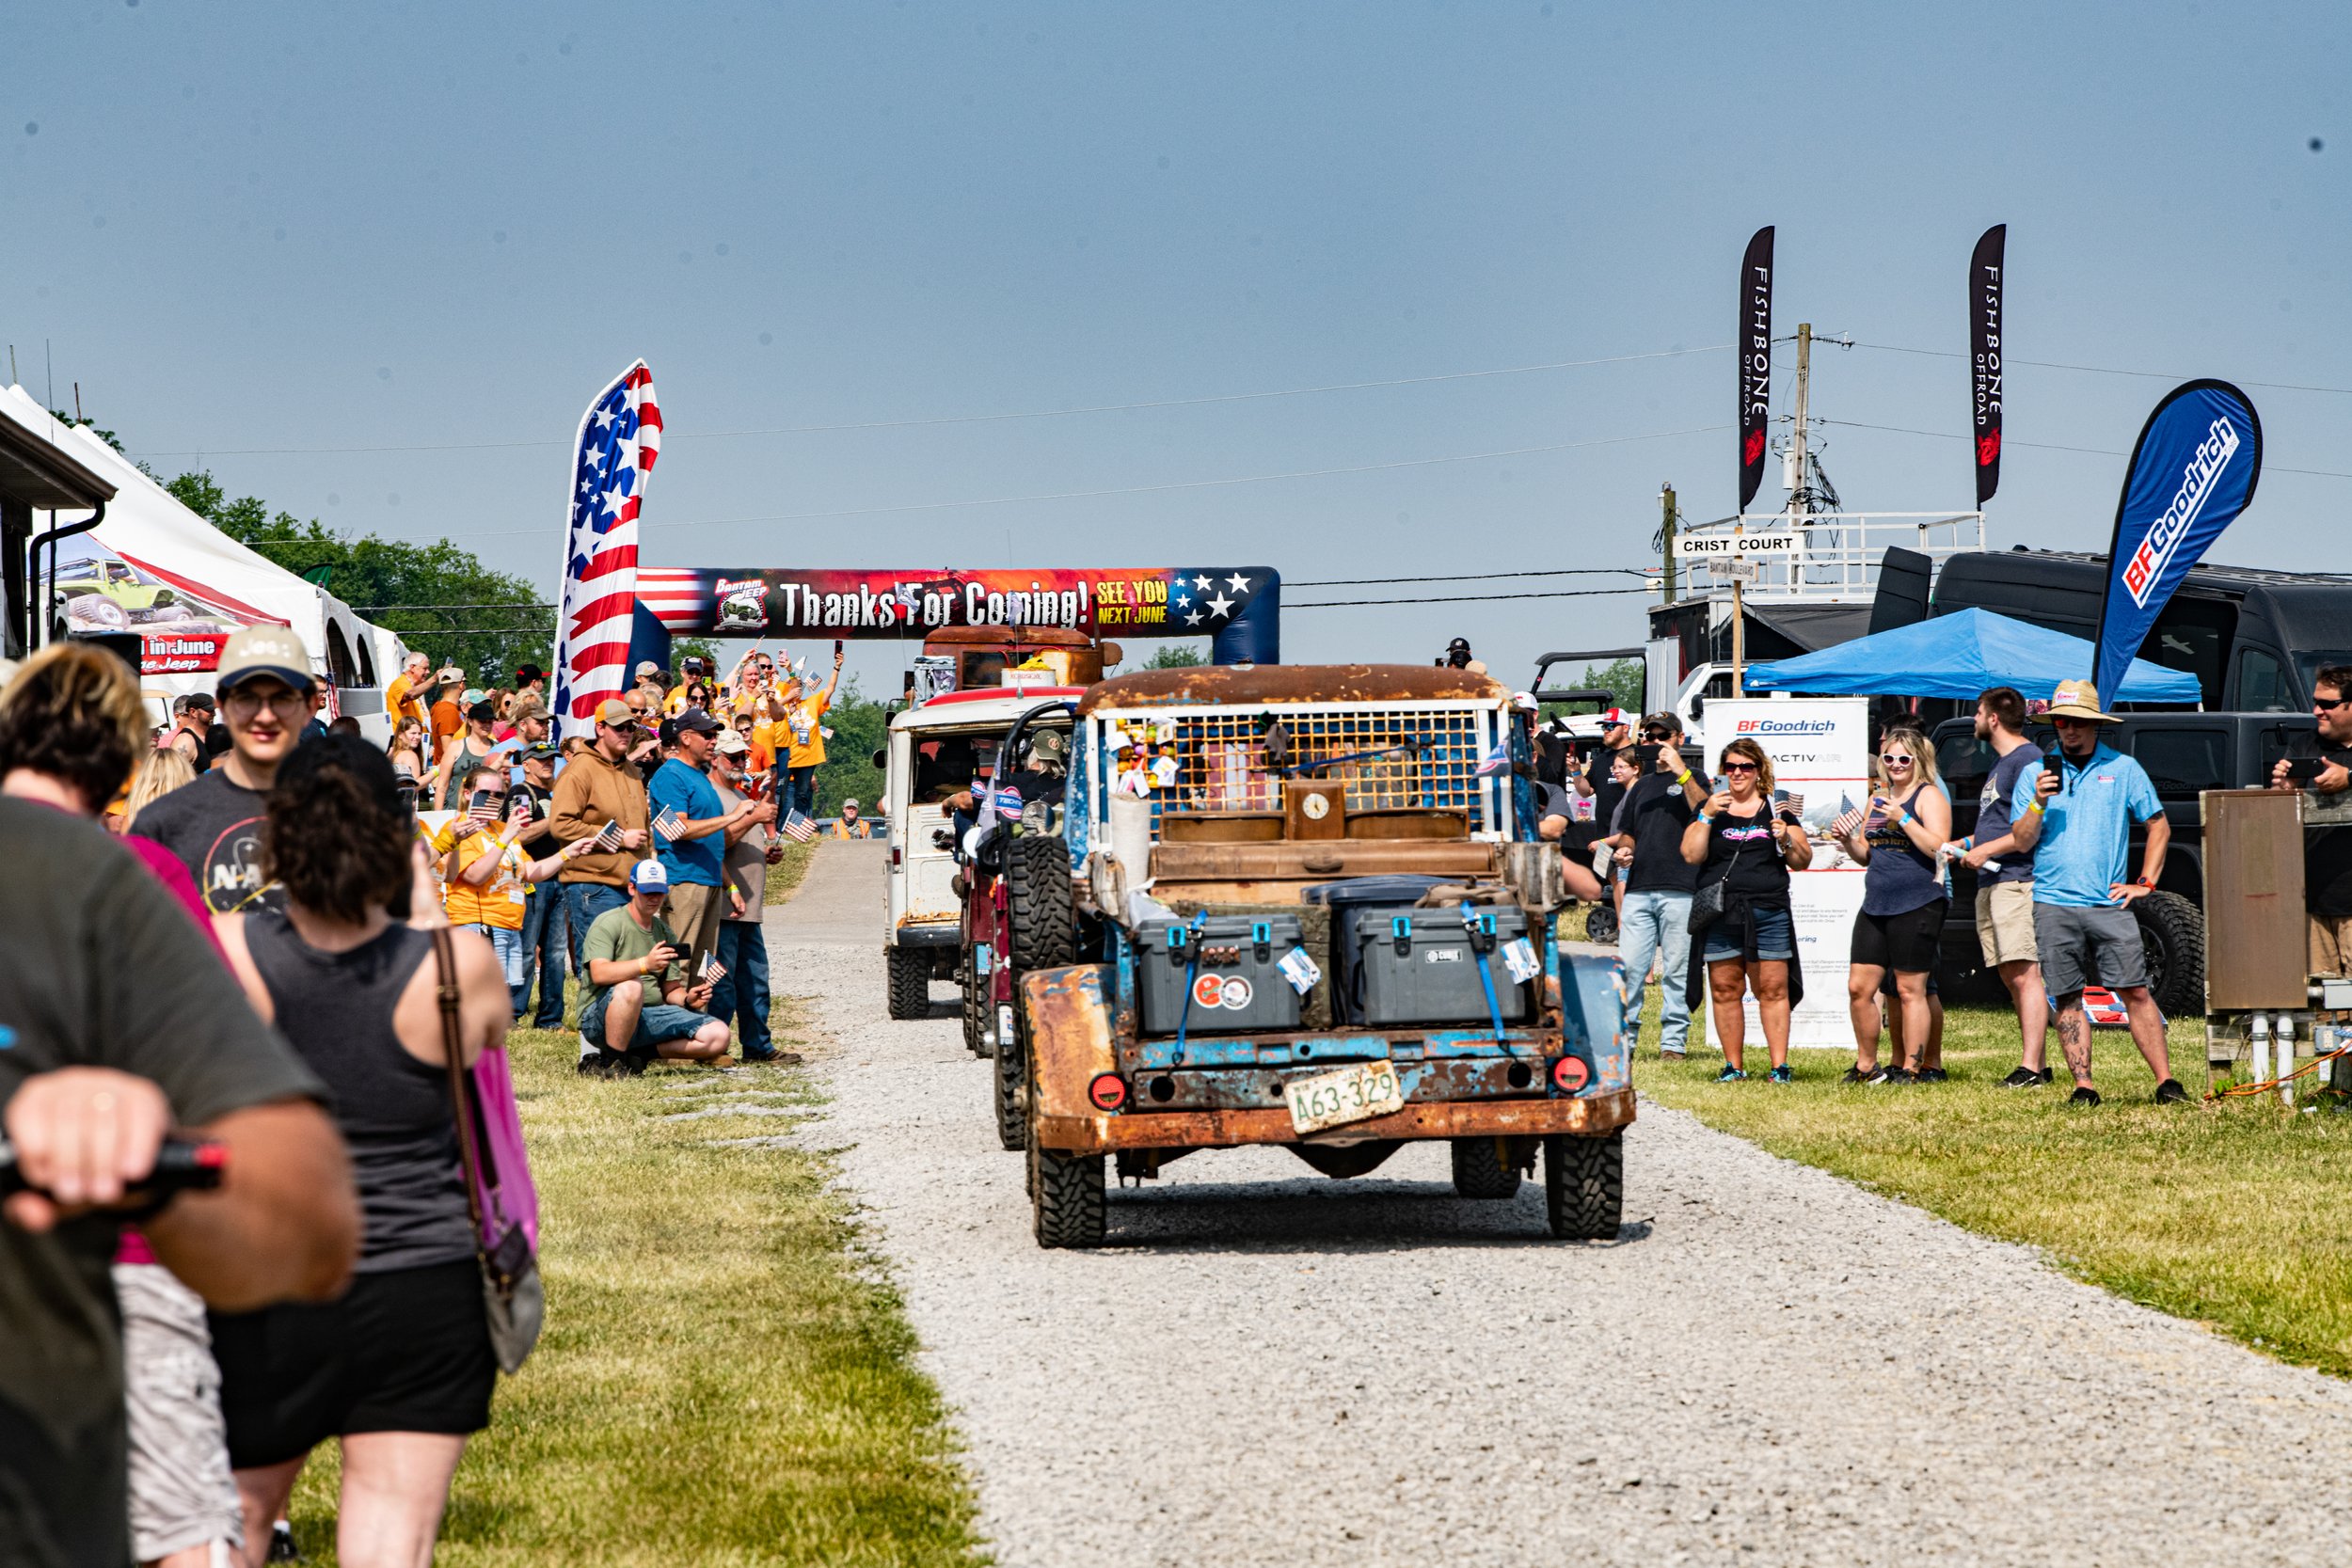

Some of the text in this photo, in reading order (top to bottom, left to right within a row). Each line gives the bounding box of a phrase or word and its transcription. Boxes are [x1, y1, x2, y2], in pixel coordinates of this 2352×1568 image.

[1753, 265, 1769, 416] FISHBONE
[1984, 264, 2002, 414] FISHBONE
[1977, 354, 1987, 425] OFFROAD
[2125, 420, 2233, 596] BFGoodrich
[1684, 538, 1793, 552] CRIST COURT
[739, 587, 768, 600] JEEP
[1097, 579, 1168, 605] SEE YOU
[780, 581, 1088, 629] Thanks For Coming!
[1098, 605, 1168, 625] NEXT JUNE
[150, 640, 166, 655] in
[170, 639, 215, 655] June
[158, 657, 200, 672] Jeep
[1737, 720, 1836, 732] BFGoodrich
[461, 759, 482, 771] Je
[1296, 1072, 1393, 1122] A63-329
